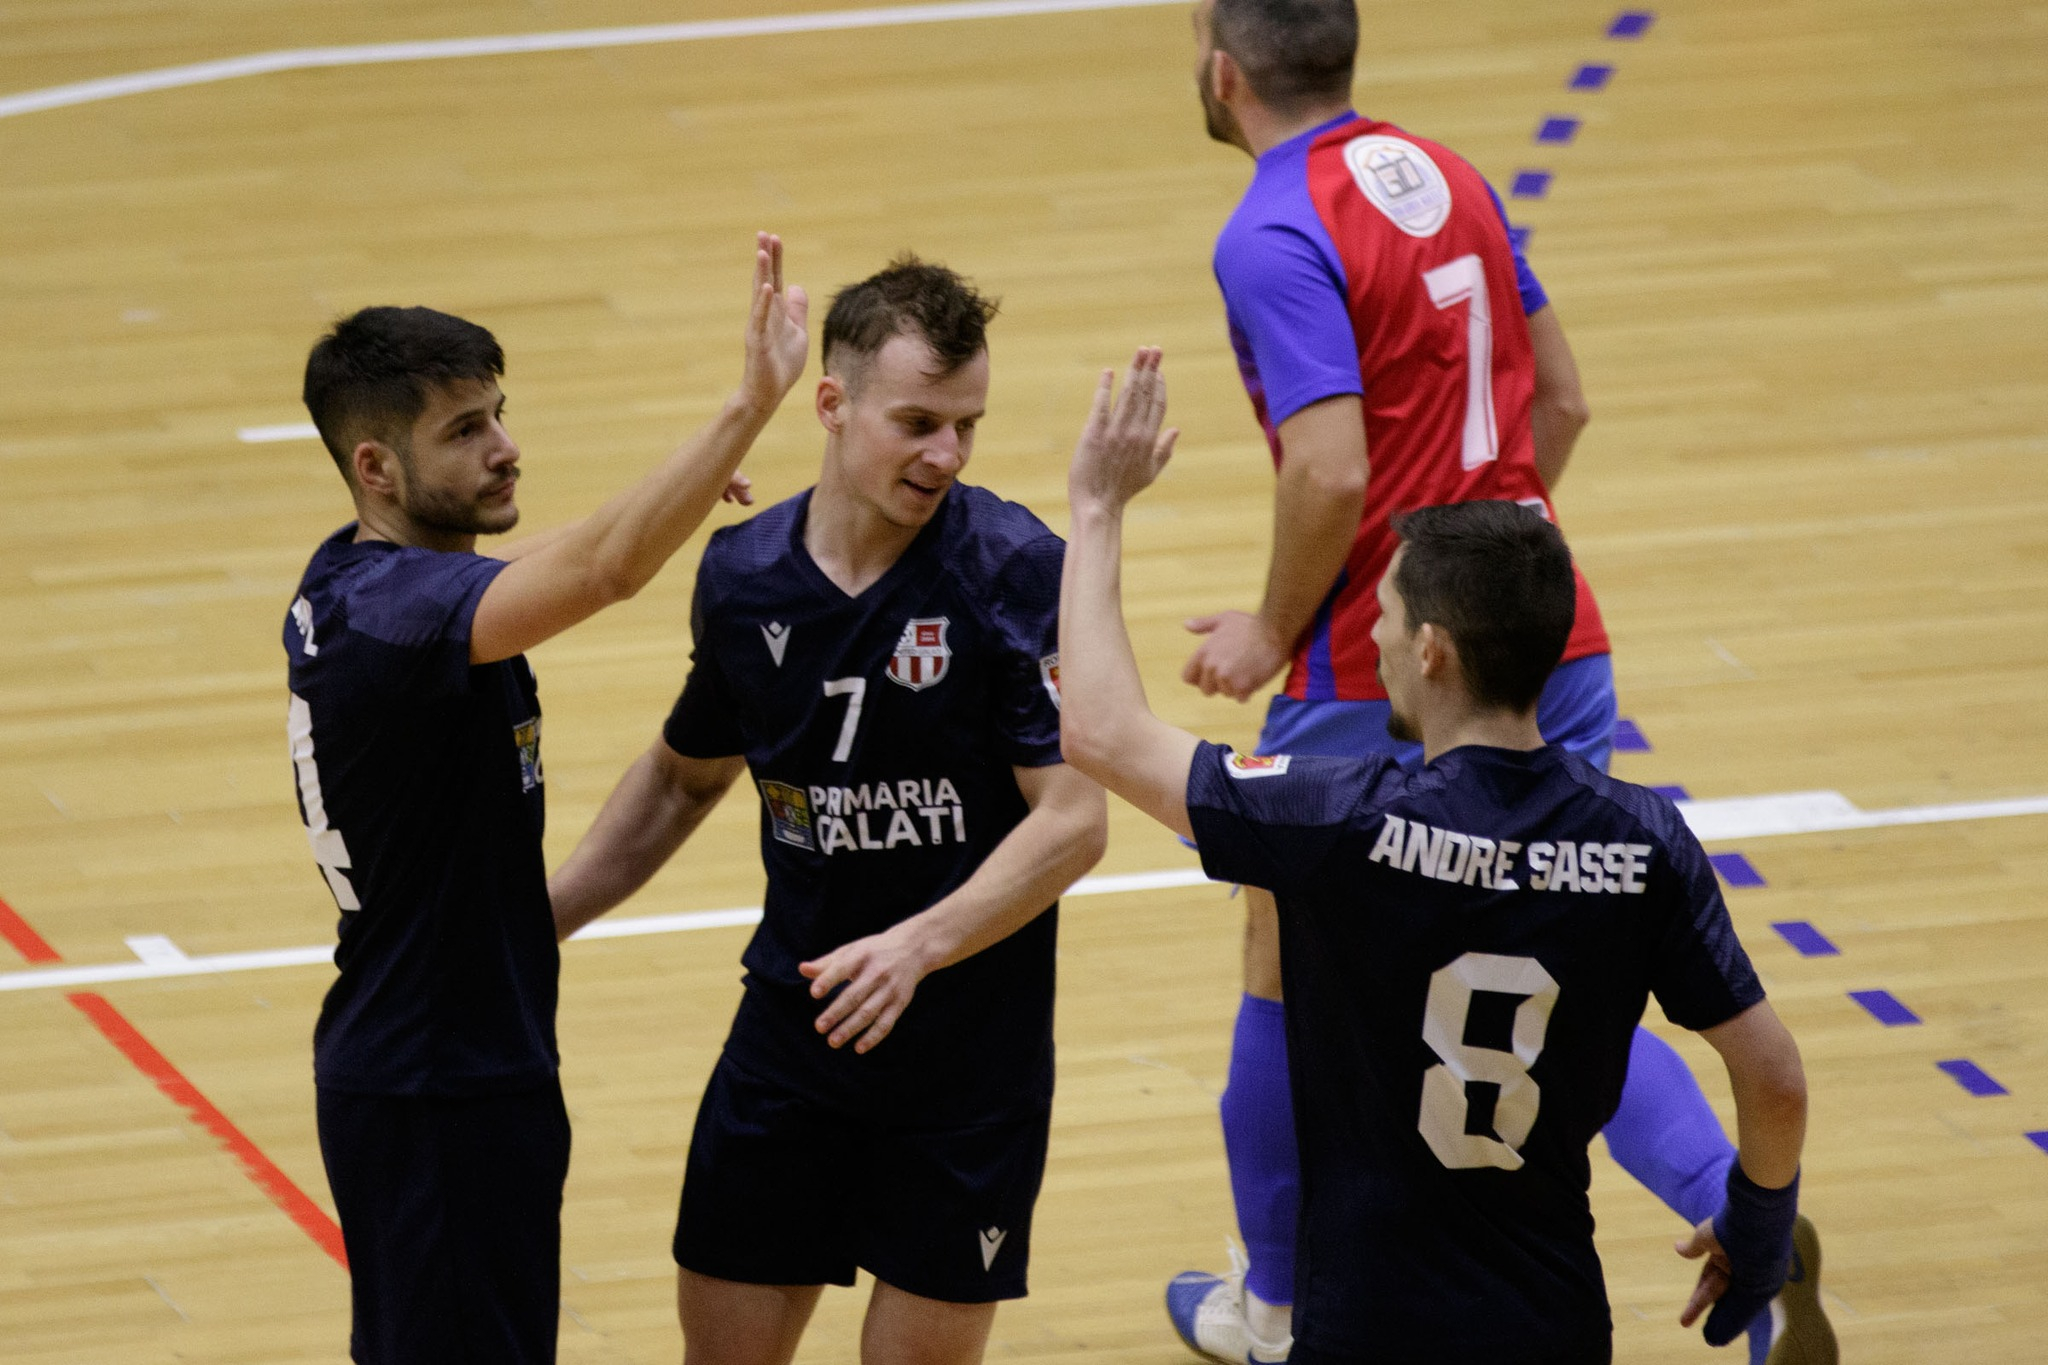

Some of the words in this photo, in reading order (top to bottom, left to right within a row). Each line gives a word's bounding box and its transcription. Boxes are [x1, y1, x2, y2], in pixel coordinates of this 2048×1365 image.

[1422, 253, 1498, 471] 7
[824, 677, 866, 762] 7
[1368, 813, 1522, 891] ANDRE
[1527, 841, 1652, 894] SASSE
[1418, 952, 1560, 1171] 8
